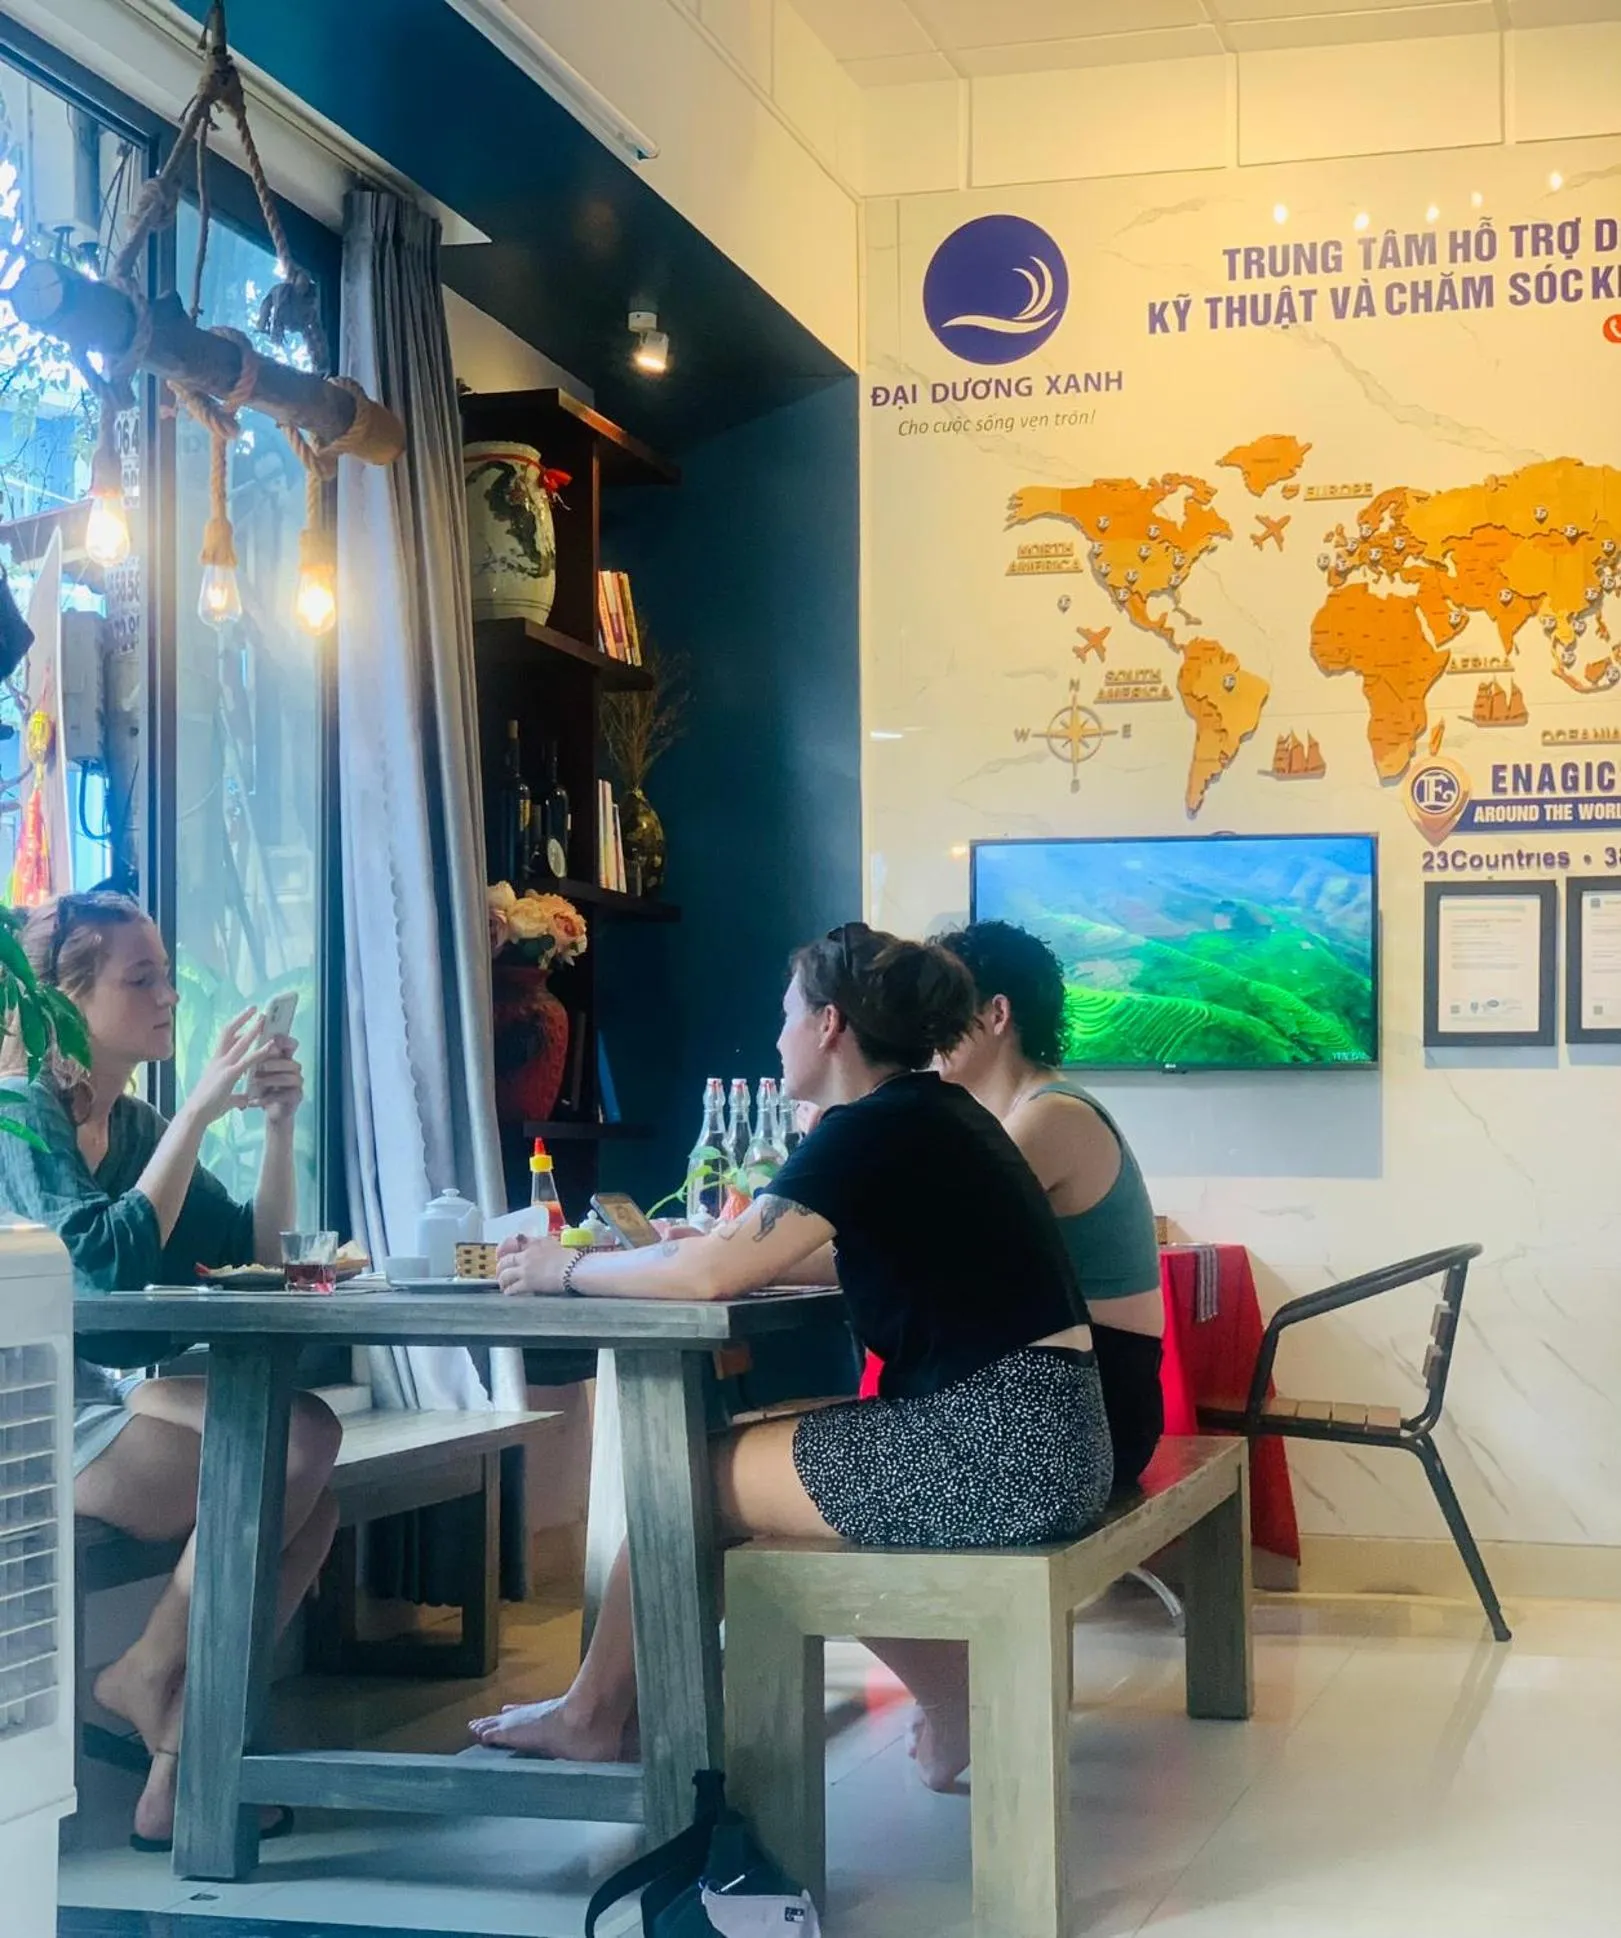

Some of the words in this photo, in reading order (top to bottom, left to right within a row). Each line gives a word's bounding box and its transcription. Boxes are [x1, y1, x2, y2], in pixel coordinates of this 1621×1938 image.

[1222, 240, 1343, 281] TRUNG
[1357, 229, 1437, 271] TÂM
[1448, 216, 1497, 263] HỖ
[1509, 217, 1582, 260] TRỢ
[1148, 293, 1192, 334] KỸ
[1204, 285, 1318, 329] THUẬT
[1329, 278, 1376, 319] VÀ
[1385, 272, 1494, 316] CHĂM
[1509, 263, 1583, 306] SÓC
[870, 384, 918, 410] ĐẠI
[931, 377, 1033, 404] DƯƠNG
[1045, 370, 1122, 396] XANH
[898, 418, 928, 437] Cho
[933, 415, 970, 434] cuộc
[1013, 726, 1031, 743] W
[1491, 761, 1616, 795] ENAGIC
[1473, 805, 1540, 823] AROUND
[1543, 804, 1573, 821] THE
